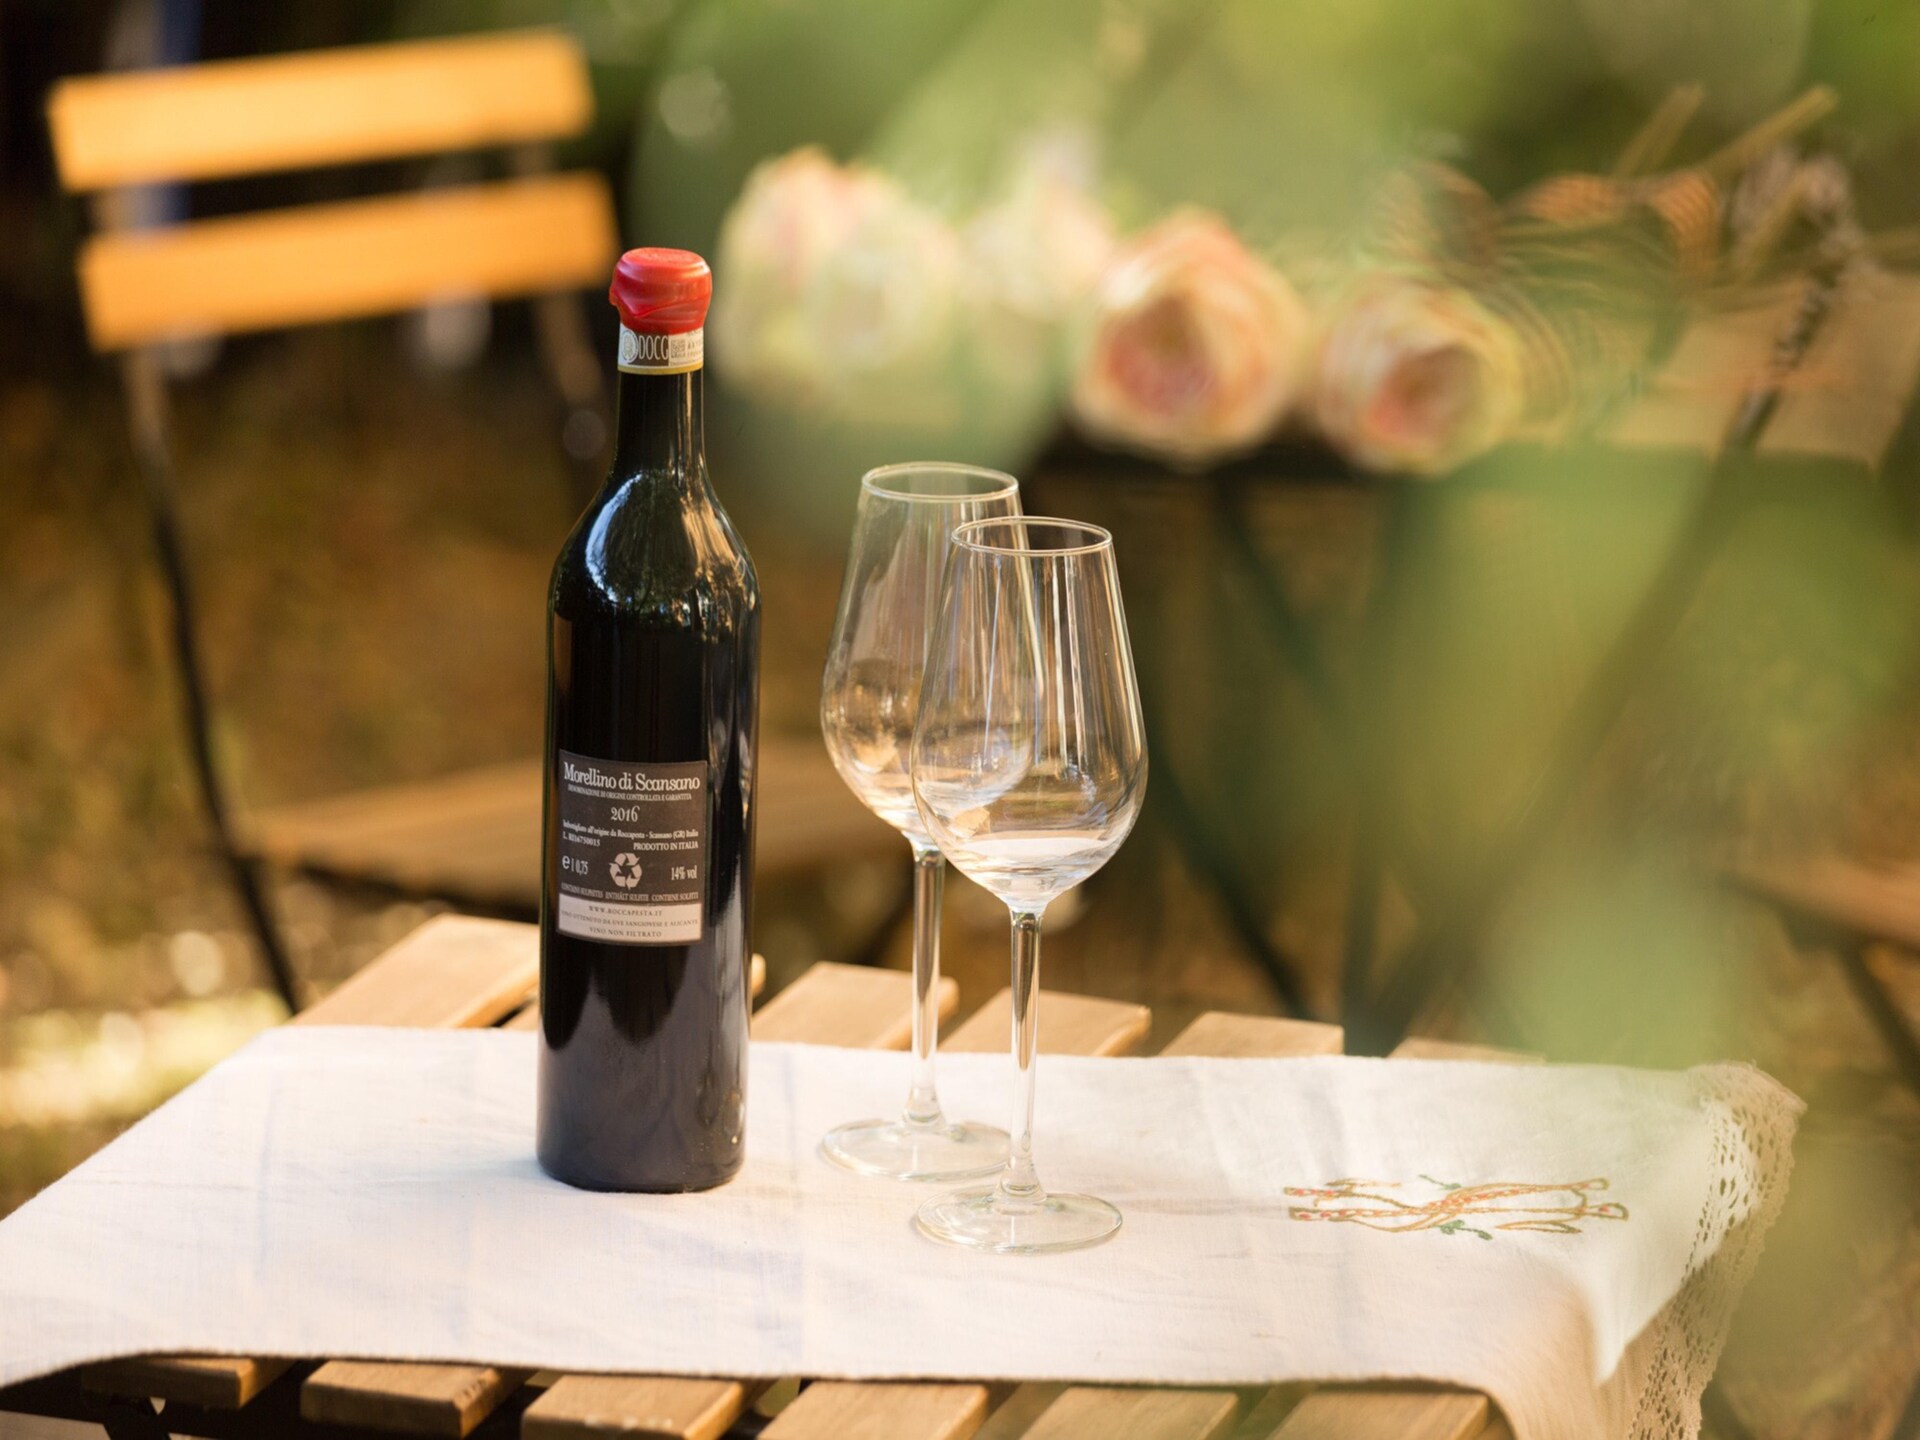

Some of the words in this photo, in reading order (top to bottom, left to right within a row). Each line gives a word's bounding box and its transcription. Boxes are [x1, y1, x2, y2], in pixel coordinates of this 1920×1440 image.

[638, 335, 669, 360] DOCG
[564, 761, 617, 789] Morellino
[618, 772, 633, 790] di
[635, 772, 700, 791] Scansano
[610, 805, 641, 822] 2016
[610, 829, 617, 837] da
[649, 831, 672, 839] Scansano
[633, 842, 669, 851] PRODOTTO
[670, 842, 677, 850] IN
[679, 840, 698, 850] ITALIA
[575, 859, 588, 875] 0,75
[671, 866, 686, 880] 14%
[687, 865, 698, 879] vol
[589, 905, 662, 916] WWW.ROCCAPESTA.IT
